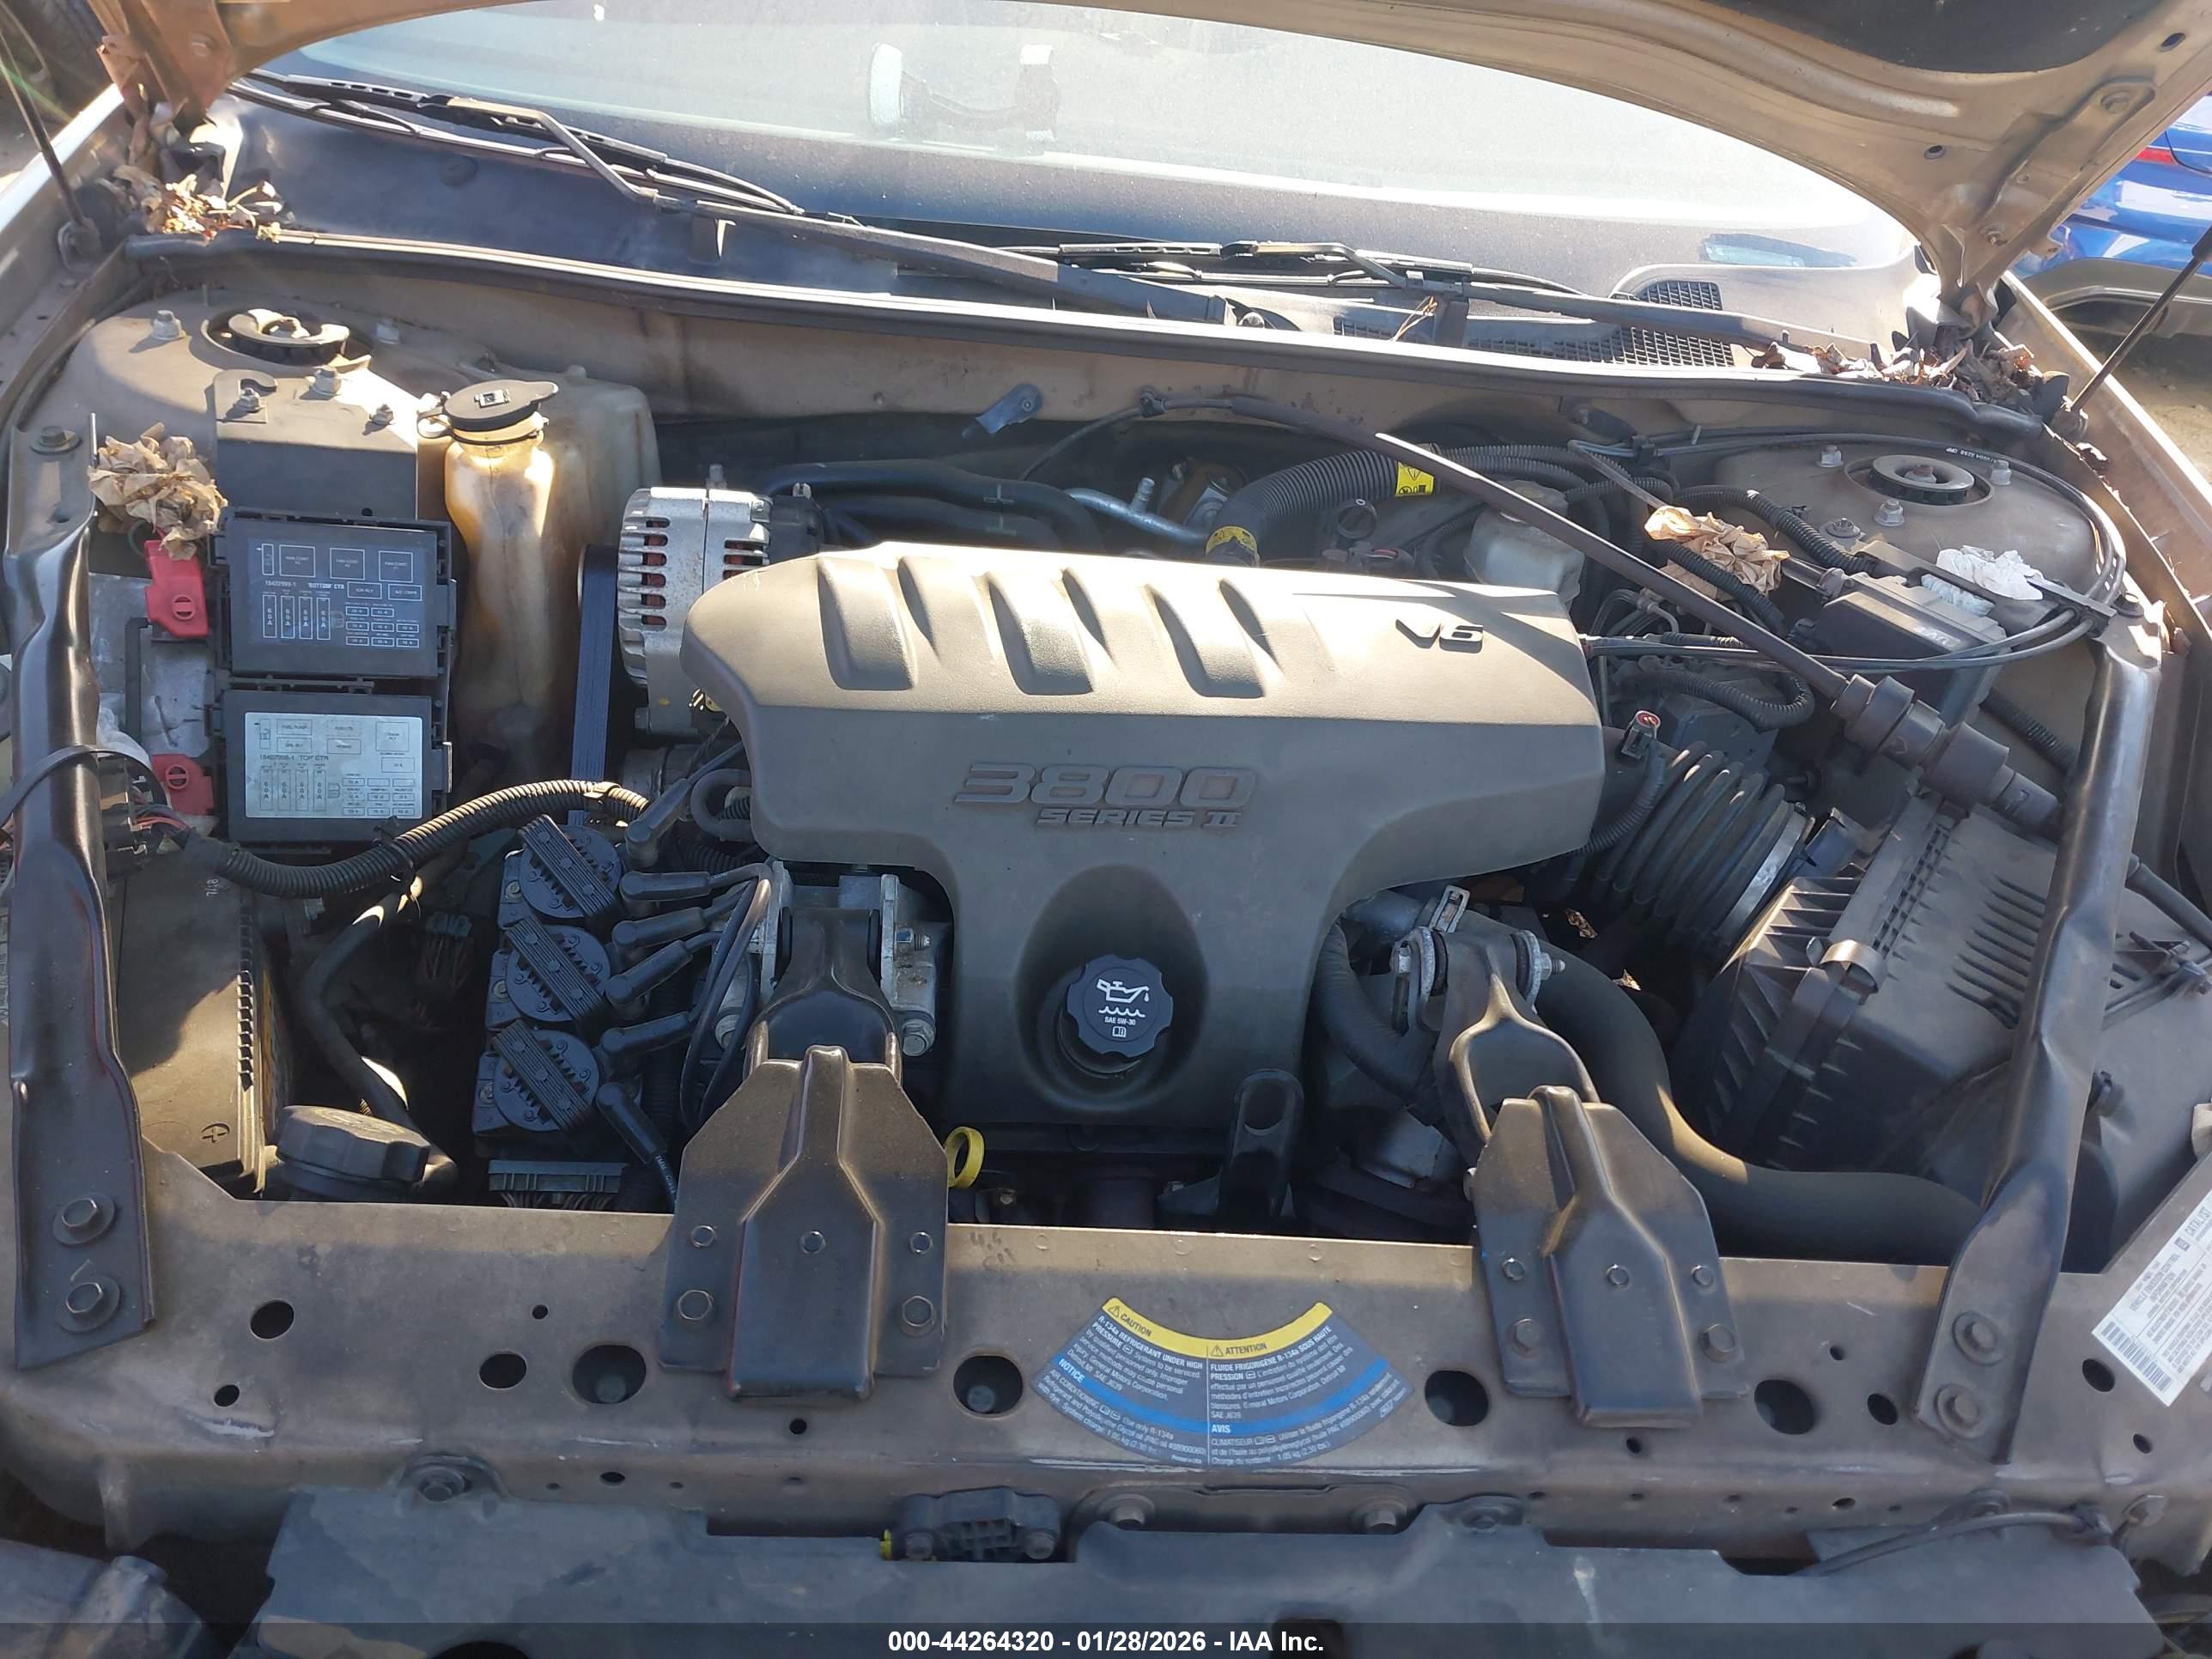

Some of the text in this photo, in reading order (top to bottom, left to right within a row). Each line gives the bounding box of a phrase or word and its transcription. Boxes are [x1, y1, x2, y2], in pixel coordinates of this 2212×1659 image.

[1395, 618, 1484, 653] V6
[953, 762, 1257, 807] 3800
[1036, 808, 1240, 829] SERIES II
[1104, 1016, 1116, 1024] SAE
[1121, 1314, 1152, 1337] CAUTION
[1098, 1316, 1203, 1369] R-134a REFRIGERANT UNDER HIGH
[1225, 1342, 1267, 1355] ATTENTION
[1297, 1339, 1315, 1352] SOUS
[1312, 1325, 1332, 1343] HAUTE
[1092, 1322, 1123, 1348] PRESSURE
[1133, 1352, 1157, 1366] System
[1174, 1368, 1200, 1378] serviced
[1058, 1358, 1085, 1383] NOTICE
[1159, 1372, 1188, 1386] Improper
[1210, 1372, 1243, 1381] PRESSION
[1156, 1382, 1183, 1394] personal
[1211, 1411, 1224, 1419] SAE
[1211, 1424, 1231, 1433] AVIS
